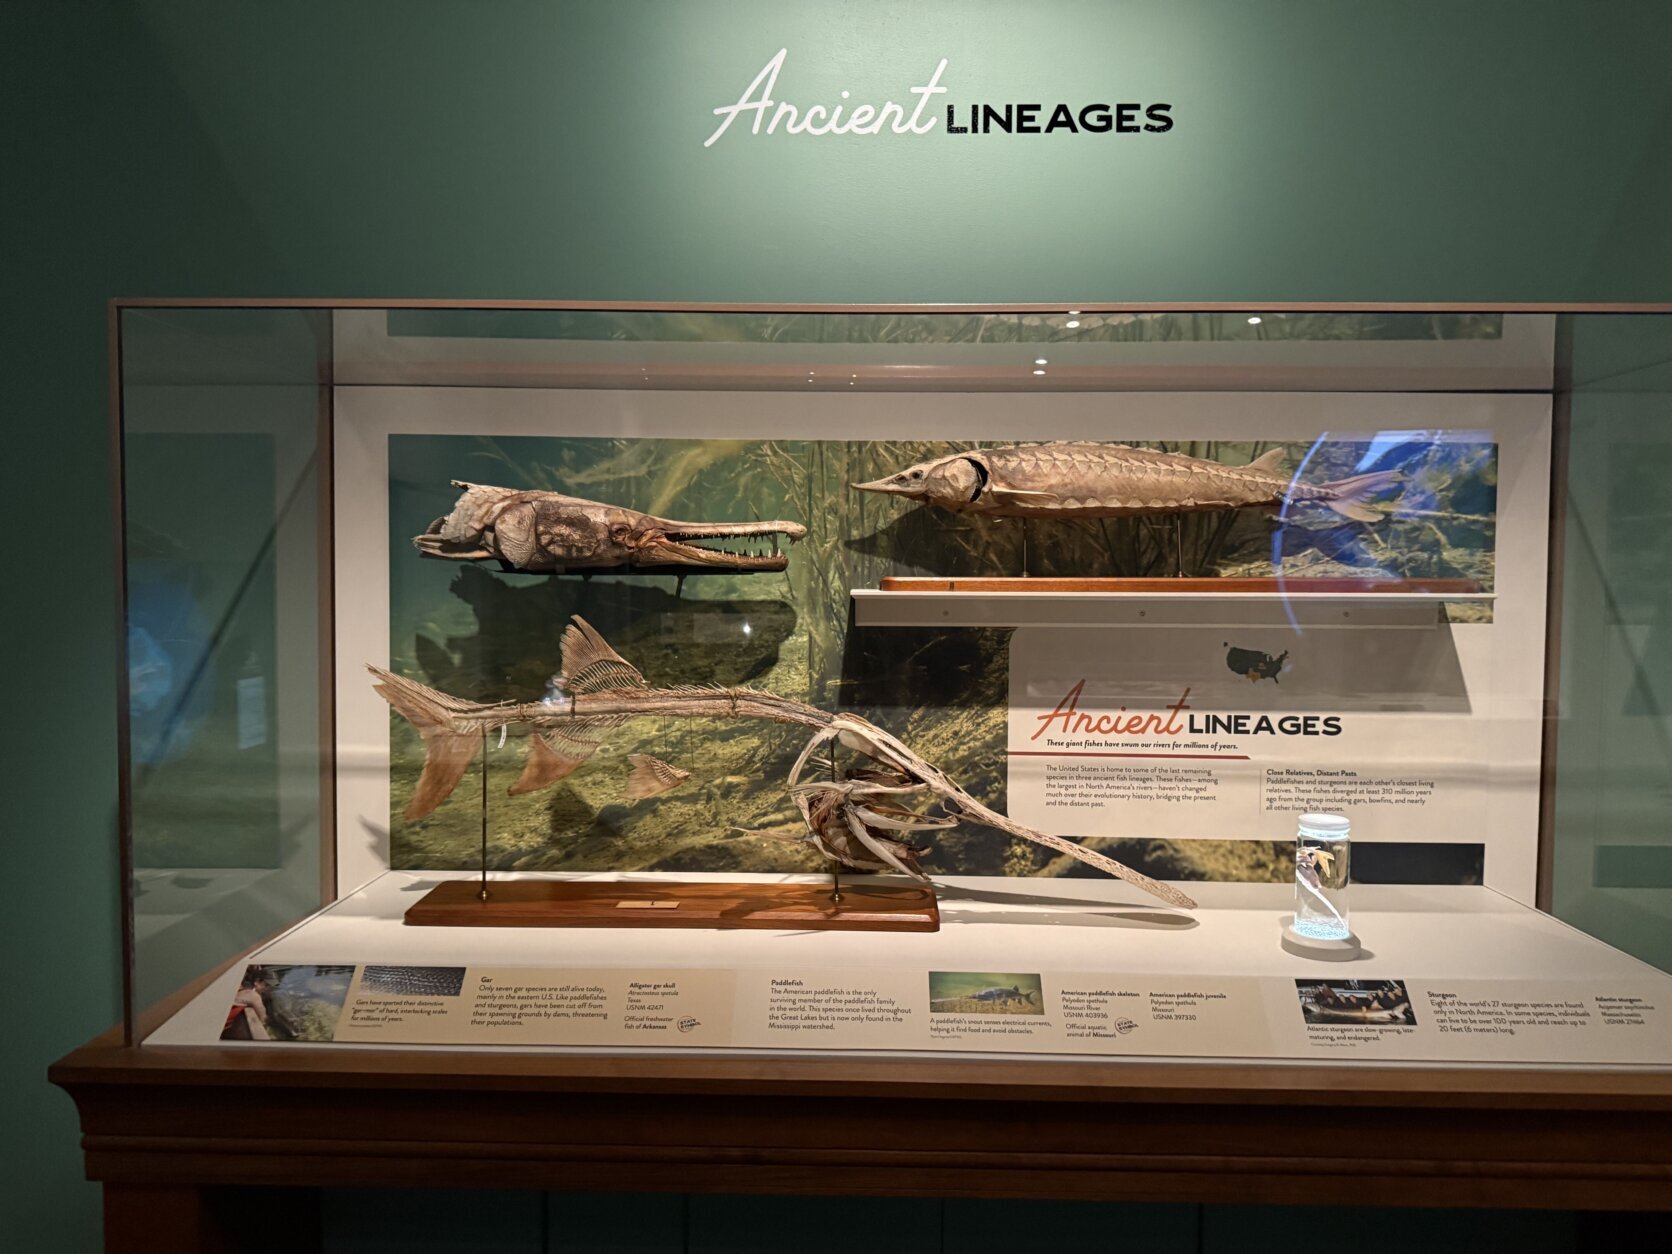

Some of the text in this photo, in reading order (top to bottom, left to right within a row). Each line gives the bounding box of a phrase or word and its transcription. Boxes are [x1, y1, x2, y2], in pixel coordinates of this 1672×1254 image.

[704, 48, 1174, 148] Ancient LINEAGES
[1030, 678, 1343, 741] Ancient LINEAGES
[1066, 739, 1083, 749] giant
[1084, 740, 1103, 749] fishes
[1172, 741, 1181, 751] for
[1210, 742, 1218, 751] of
[1182, 767, 1212, 776] remaining
[1286, 769, 1315, 777] Relatives,
[1046, 773, 1067, 783] species
[1129, 775, 1154, 784] lineages.
[1318, 778, 1347, 788] sturgeons
[1419, 780, 1434, 789] living
[1058, 782, 1077, 792] largest
[1181, 784, 1207, 794] changed
[1332, 787, 1357, 796] diverged
[1094, 792, 1130, 801] evolutionary
[1132, 792, 1155, 802] history,
[1156, 793, 1180, 802] bridging
[1193, 793, 1216, 803] present
[1325, 796, 1352, 805] including
[1369, 796, 1393, 804] bowfins,
[1407, 797, 1426, 806] nearly
[1091, 800, 1105, 809] past.
[1292, 804, 1308, 813] living
[1322, 804, 1344, 814] species.
[479, 985, 494, 994] Only
[526, 985, 546, 994] species
[586, 986, 605, 994] today,
[814, 988, 844, 998] paddlefish
[864, 989, 877, 998] only
[770, 996, 796, 1005] surviving
[844, 997, 875, 1006] paddlefish
[876, 998, 895, 1007] family
[822, 1006, 843, 1015] species
[877, 1007, 911, 1016] throughout
[851, 1015, 864, 1024] only
[768, 1022, 800, 1031] Mississippi
